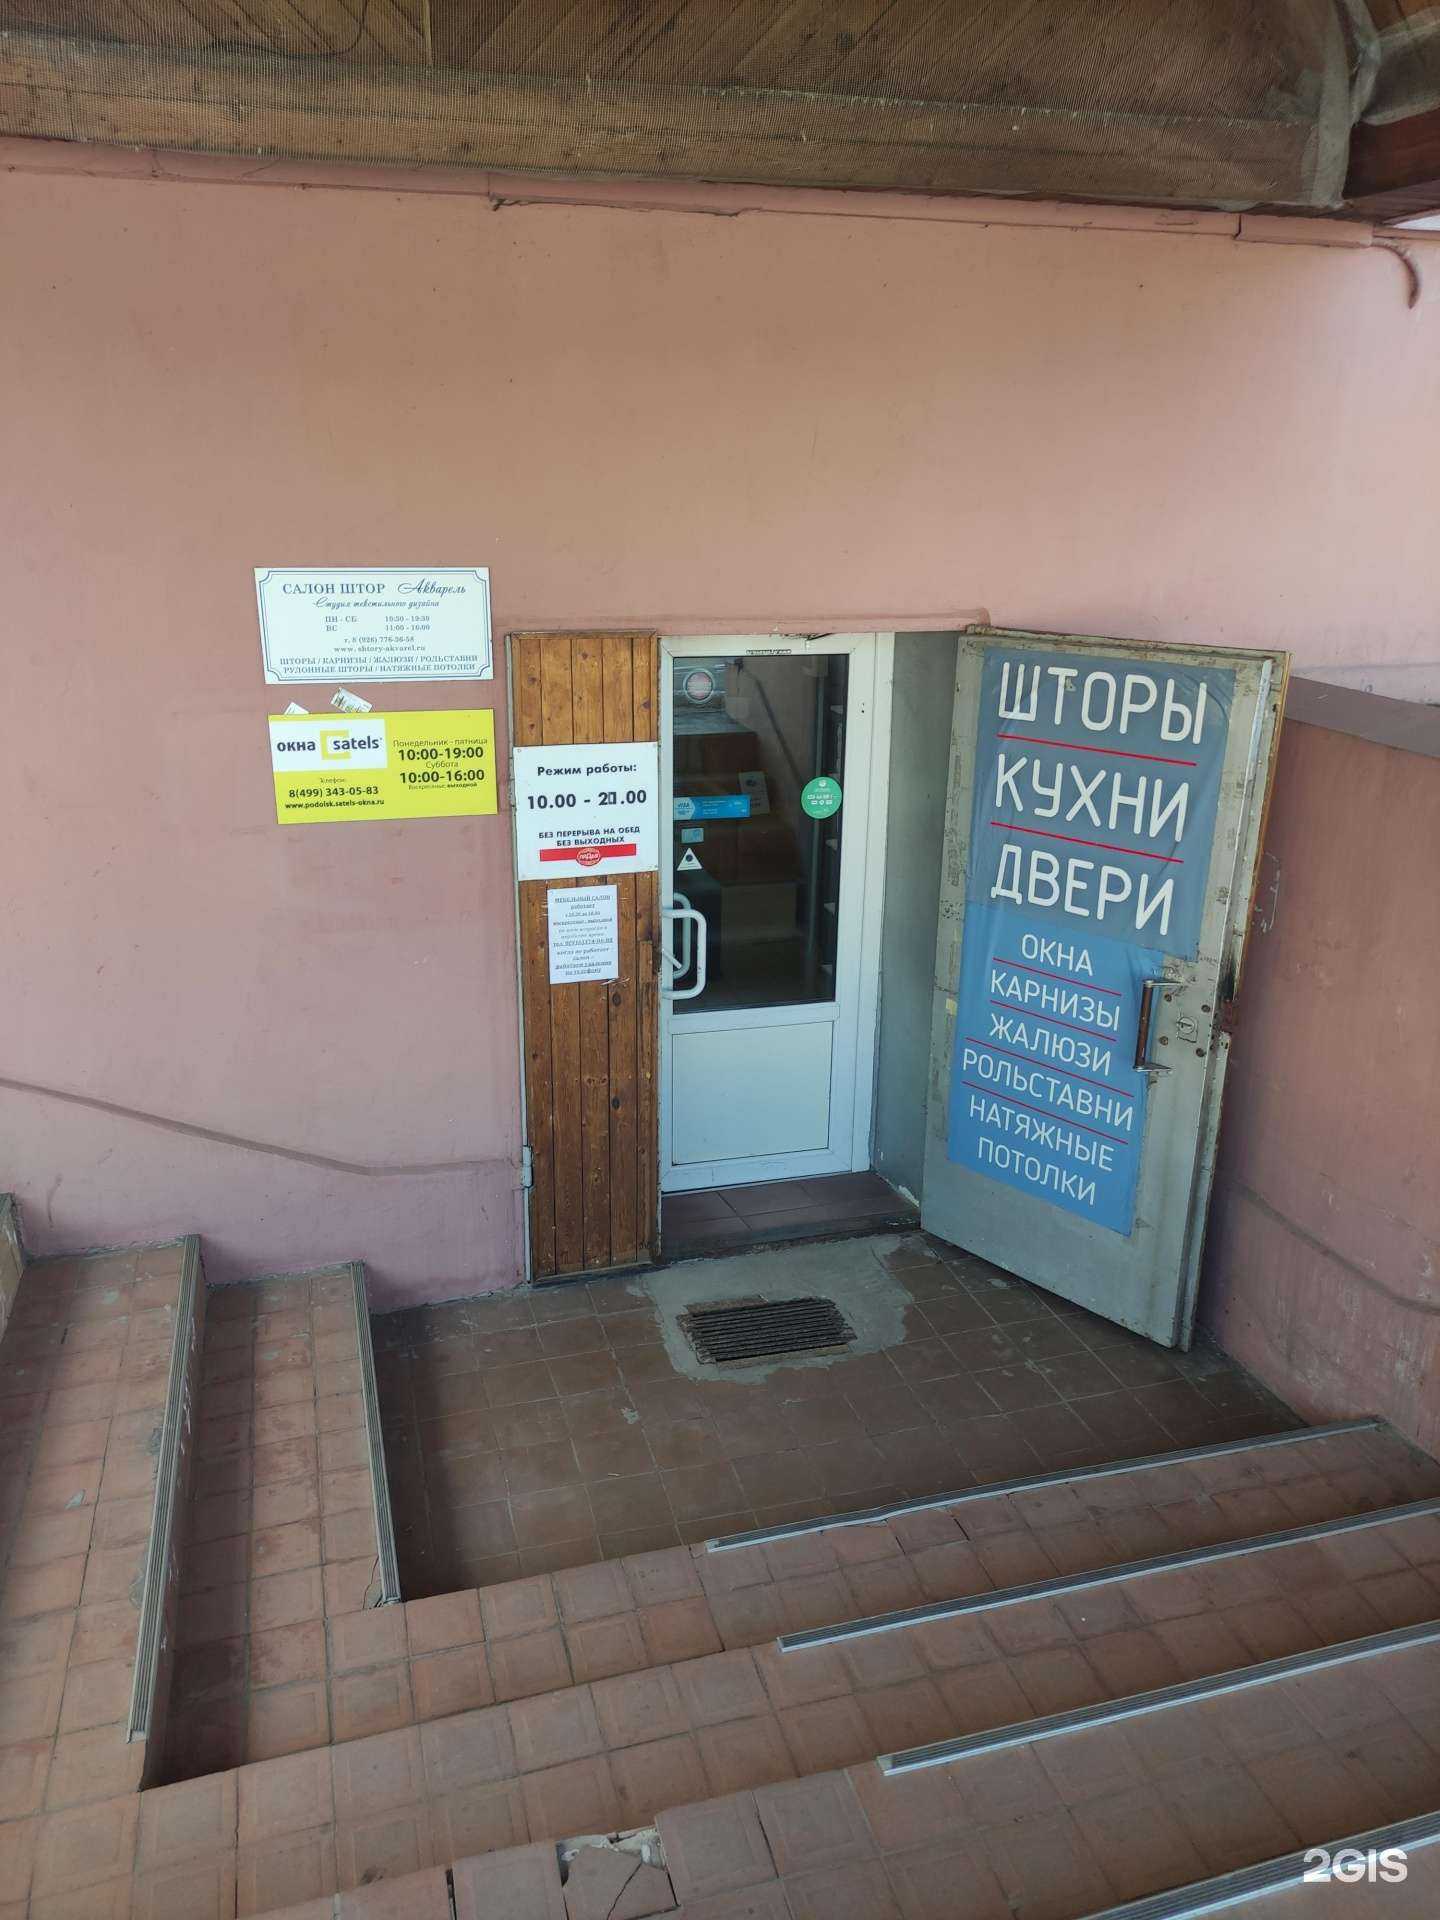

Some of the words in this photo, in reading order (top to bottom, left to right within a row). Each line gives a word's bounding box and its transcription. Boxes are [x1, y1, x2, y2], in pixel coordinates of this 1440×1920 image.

[282, 583, 335, 594] САЛОН
[340, 583, 386, 594] ШТОР
[397, 578, 466, 596] Акварель
[312, 597, 350, 608] Студия
[280, 657, 316, 666] ШТОРЫ
[322, 656, 368, 665] КАРНИЗЫ
[373, 656, 414, 664] ЖАЛЮЗИ
[420, 655, 478, 664] РОЛЬСТАВНИ
[284, 666, 336, 674] РУЛОННЫЕ
[338, 666, 373, 674] ШТОРЫ
[380, 664, 432, 673] НАТЯЖНЫЕ
[433, 664, 476, 672] ПОТОЛКИ
[998, 661, 1207, 745] ШТОРЫ
[276, 740, 316, 752] окна
[332, 736, 380, 750] satels
[393, 739, 448, 748] Понедельник
[398, 746, 484, 761] 10:00-19:00
[426, 760, 459, 770] Суббота
[538, 766, 582, 776] Режим
[586, 764, 637, 776] работы:
[400, 769, 485, 784] 10:00-16:00
[288, 788, 323, 798] 8(499)
[326, 786, 379, 797] 343-05-83
[996, 754, 1190, 842] КУХНИ
[285, 799, 384, 810] www.podolsk.satels-okna.ru
[528, 794, 576, 810] 10.00
[556, 829, 600, 838] ПЕРЕРЫВА
[618, 826, 640, 834] ОБЕД
[574, 836, 625, 846] ВЫХОДНЫХ
[990, 844, 1175, 936] ДВЕРИ
[1021, 934, 1094, 976] ОКНА
[991, 969, 1120, 1032] КАРНИЗЫ
[990, 1012, 1112, 1076] ЖАЛЮЗИ
[962, 1048, 1134, 1132] РОЛЬСТАВНИ
[969, 1095, 1114, 1172] НАТЯЖНЫЕ
[978, 1136, 1096, 1206] ПОТОЛКИ
